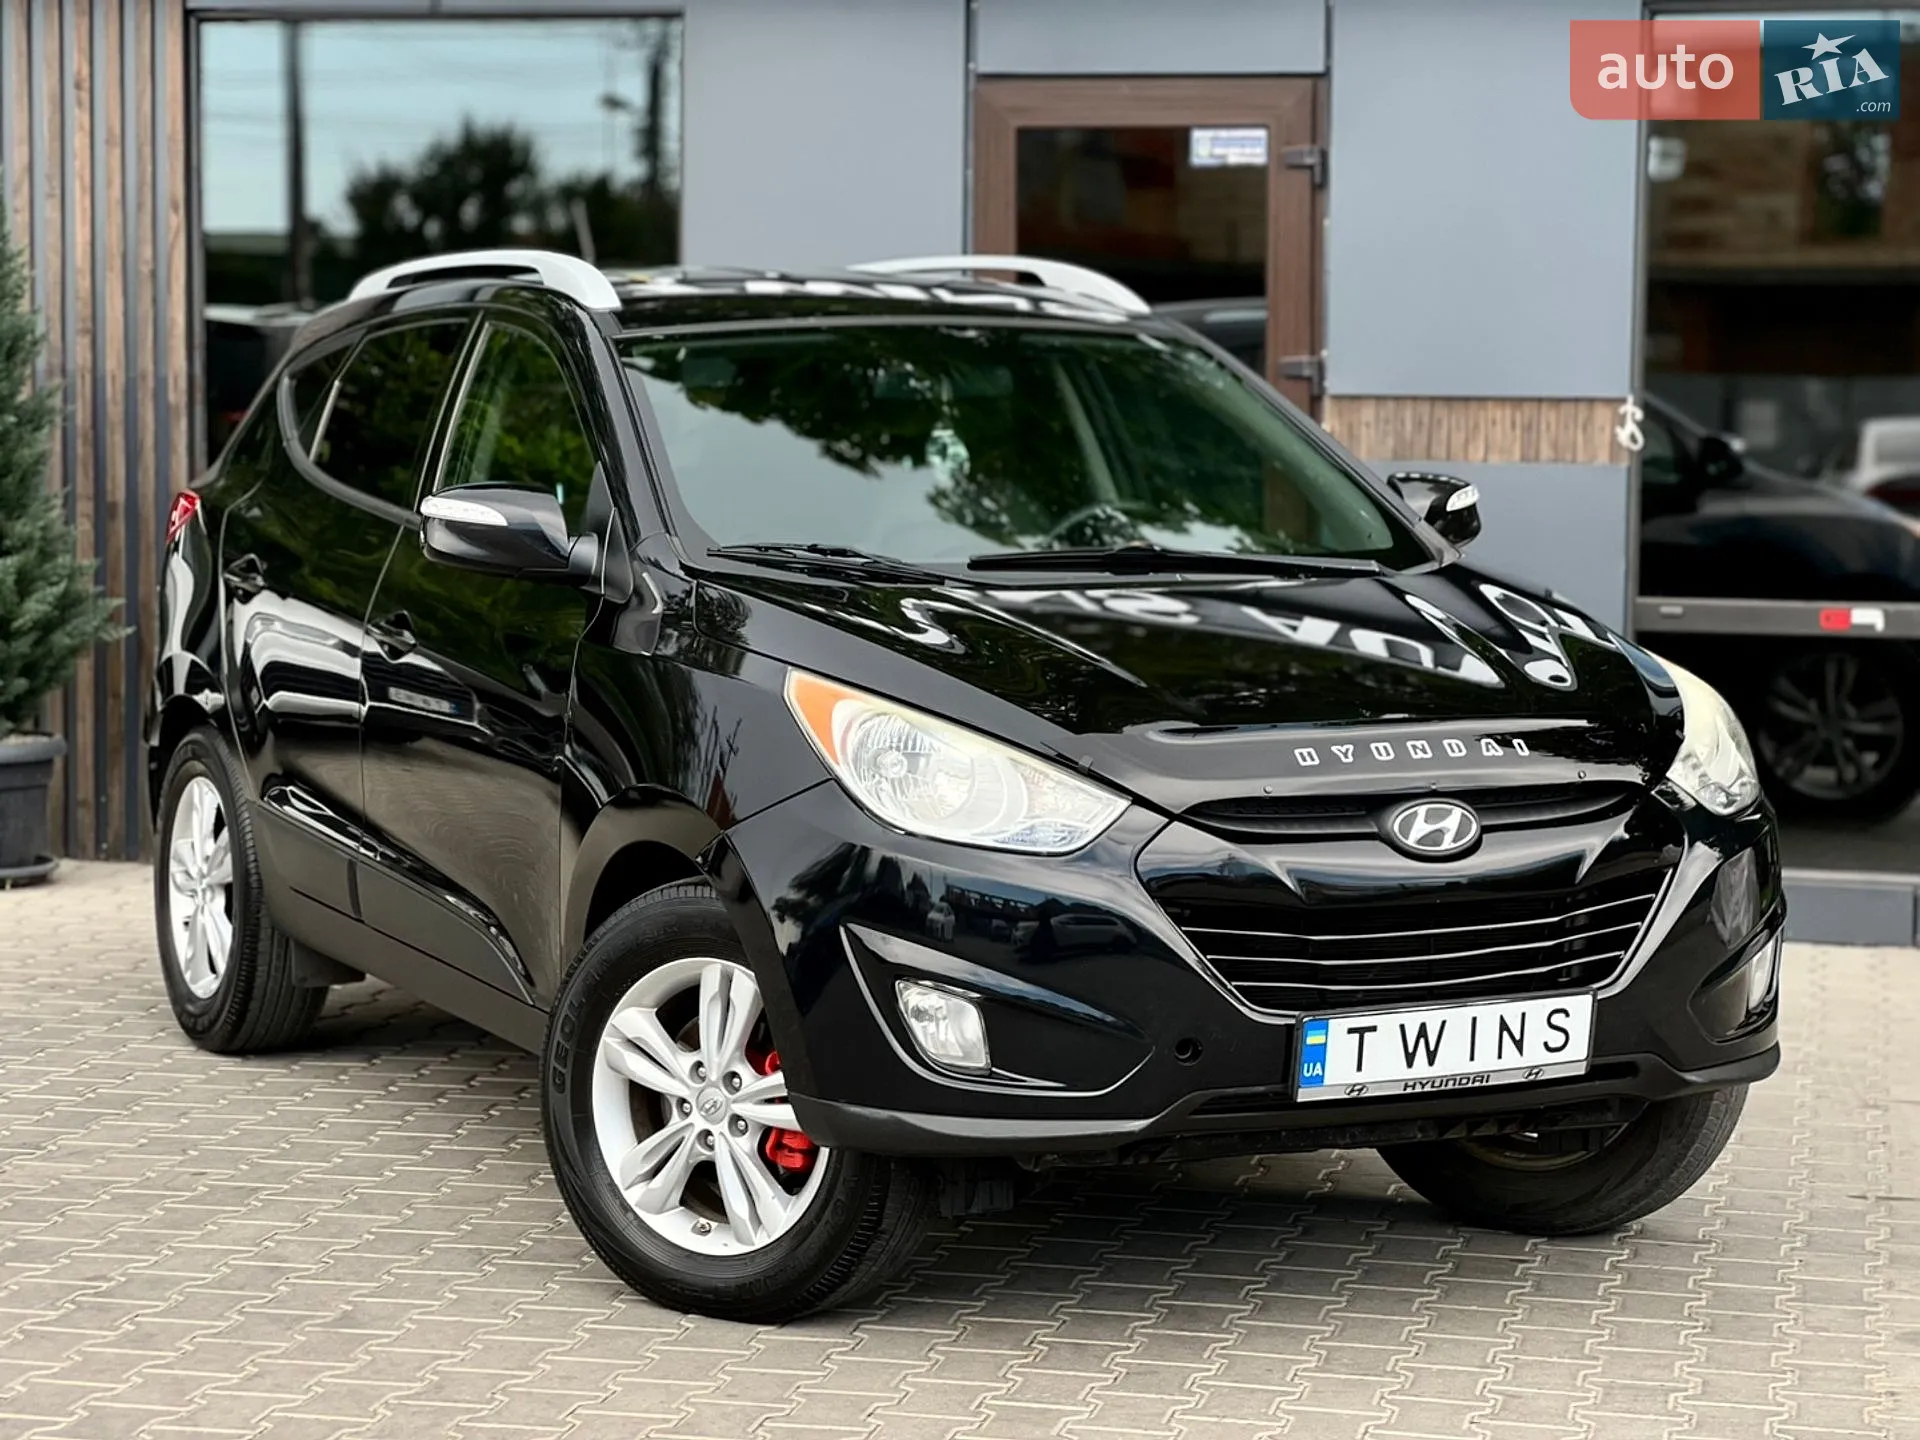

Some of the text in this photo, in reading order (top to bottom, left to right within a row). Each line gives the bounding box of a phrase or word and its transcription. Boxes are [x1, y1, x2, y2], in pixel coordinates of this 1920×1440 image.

[1294, 738, 1530, 766] HYUNDAI
[1346, 1007, 1571, 1073] TWINS
[1303, 1062, 1323, 1078] UA
[1402, 1074, 1491, 1093] HYUNDAI
